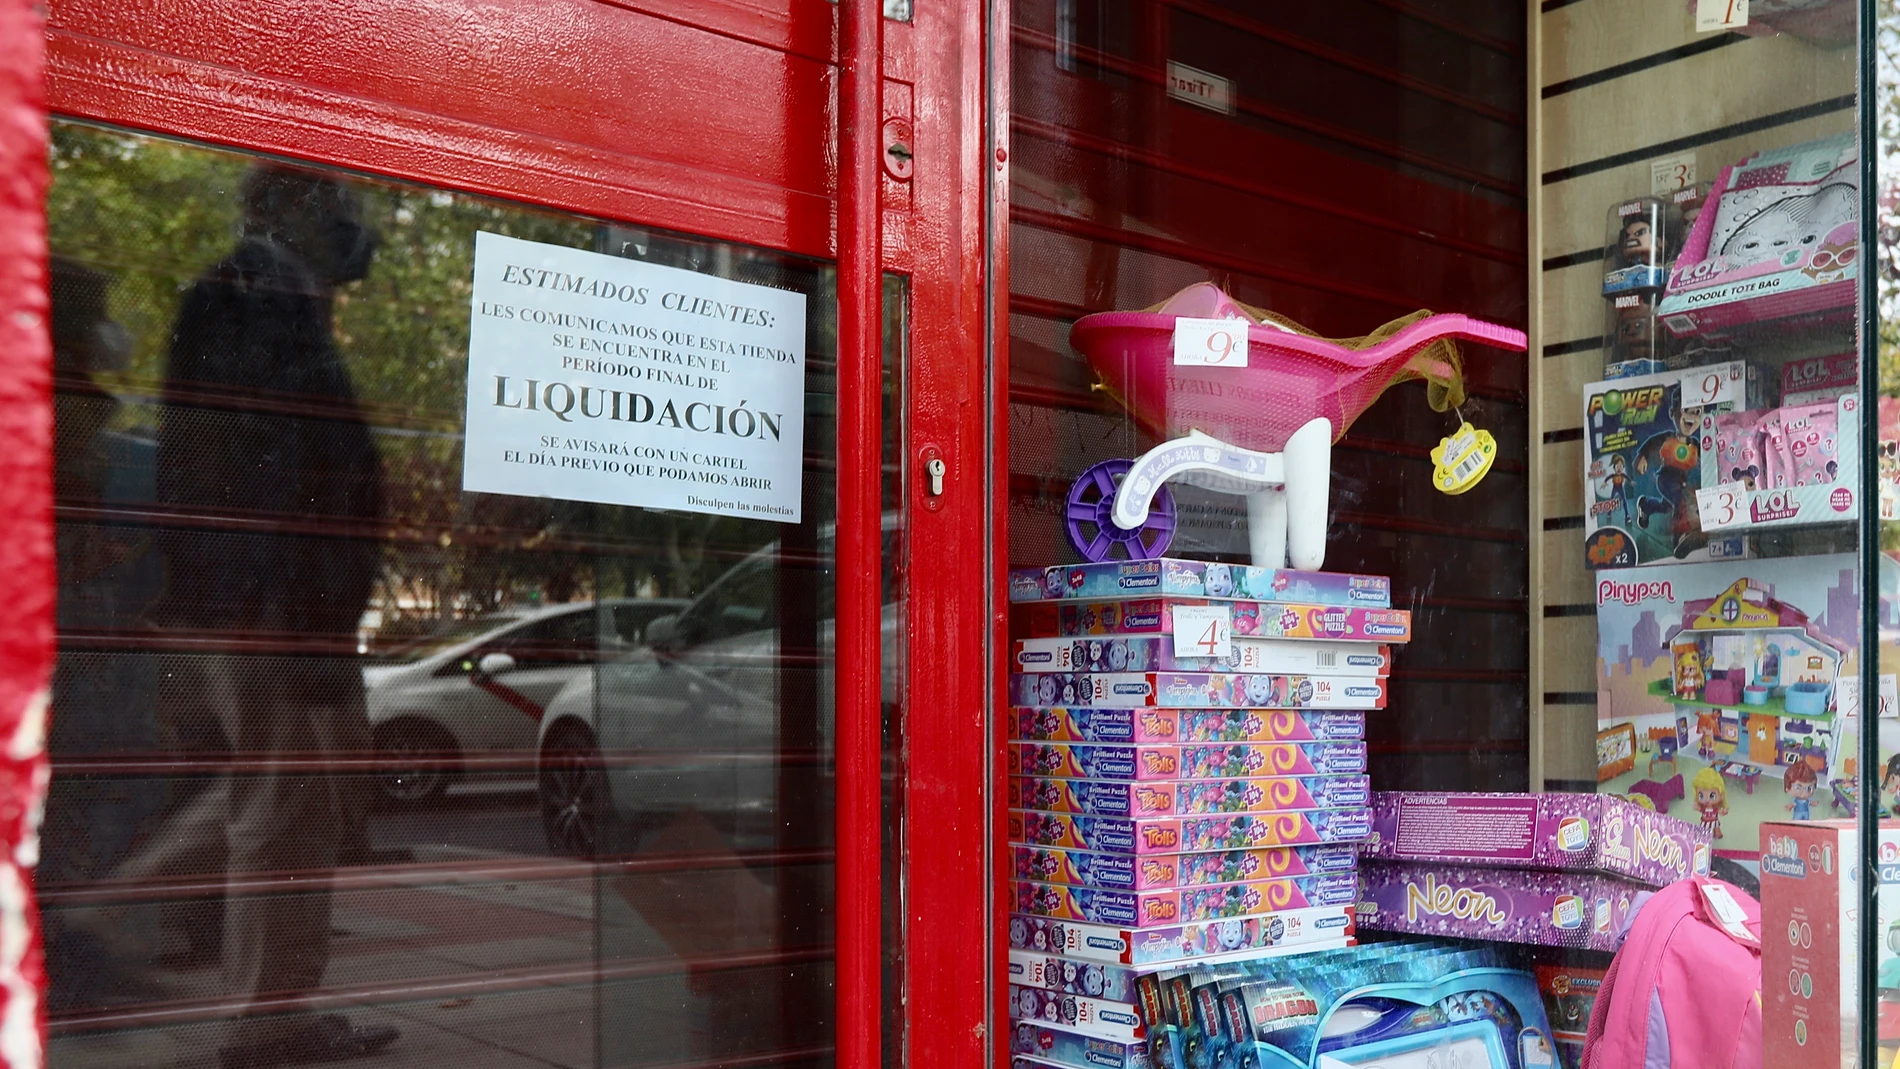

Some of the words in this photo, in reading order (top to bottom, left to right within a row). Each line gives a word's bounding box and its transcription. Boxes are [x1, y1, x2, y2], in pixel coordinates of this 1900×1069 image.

[1674, 188, 1697, 203] MARVEL
[1618, 203, 1641, 216] MARVEL
[501, 264, 649, 306] ESTIMADOS
[661, 291, 776, 328] CLIENTES:
[1688, 289, 1727, 304] DOODLE
[1731, 283, 1756, 295] TOTE
[1758, 278, 1781, 290] BAG
[1615, 295, 1639, 309] MARVEL
[481, 301, 515, 320] LES
[519, 307, 658, 342] COMUNICAMOS
[661, 329, 696, 348] QUE
[699, 336, 737, 355] ESTA
[739, 343, 797, 364] TIENDA
[552, 333, 575, 349] SE
[580, 337, 683, 366] ENCUENTRA
[686, 353, 707, 370] EN
[710, 358, 731, 374] EL
[562, 355, 642, 380] PERÍODO
[647, 367, 695, 388] FINAL
[697, 376, 719, 391] DE
[1792, 359, 1830, 381] LOL
[1588, 387, 1664, 416] POWER
[492, 374, 783, 443] LIQUIDACIÓN
[1788, 418, 1812, 431] LOL
[540, 435, 560, 449] SE
[563, 437, 630, 457] AVISARÁ
[634, 446, 666, 462] CON
[669, 450, 689, 464] UN
[692, 453, 748, 471] CARTEL
[503, 450, 526, 465] EL
[528, 449, 557, 467] DÍA
[560, 456, 620, 474] PREVIO
[623, 462, 655, 478] QUE
[658, 466, 729, 487] PODAMOS
[730, 477, 773, 491] ABRIR
[687, 494, 735, 511] Disculpen
[736, 500, 751, 512] las
[752, 501, 795, 516] molestias
[1756, 490, 1801, 514] LOL
[1590, 498, 1620, 518] ¡STOP!
[1757, 510, 1793, 522] SURPRISE!
[1616, 553, 1628, 563] x2
[1126, 577, 1158, 588] Clementoni
[1356, 591, 1386, 601] Clementoni
[1599, 580, 1675, 607] Pinypon
[1131, 616, 1159, 627] Clementoni
[1323, 613, 1346, 622] GLITTER
[1324, 622, 1345, 632] PUZZLE
[1373, 625, 1404, 635] Clementoni
[1025, 653, 1051, 661] Clementoni
[1062, 646, 1070, 668] 104
[1244, 646, 1253, 668] 104
[1095, 678, 1103, 700] 104
[1316, 681, 1331, 692] 104
[1350, 687, 1379, 696] Clementoni
[1113, 713, 1131, 721] Puzzle
[1100, 725, 1129, 734] Clementoni
[1330, 726, 1360, 734] Clementoni
[1116, 751, 1133, 759] Puzzle
[1102, 763, 1133, 772] Clementoni
[1331, 758, 1361, 767] Clementoni
[1333, 792, 1365, 801] Clementoni
[1403, 797, 1448, 805] ADVERTENCIAS
[1098, 799, 1127, 808] Clementoni
[1116, 824, 1134, 832] Puzzle
[1336, 825, 1368, 834] Clementoni
[1563, 824, 1581, 835] CEFA
[1103, 835, 1133, 846] Clementoni
[1566, 834, 1584, 845] TOYS
[1634, 815, 1687, 874] Neon
[1770, 835, 1798, 860] baby
[1323, 857, 1352, 866] Clementoni
[1771, 858, 1804, 876] Clementoni
[1100, 871, 1132, 882] Clementoni
[1325, 890, 1353, 899] Clementoni
[1407, 874, 1505, 925] Neon
[1116, 896, 1135, 905] Puzzle
[1103, 907, 1134, 918] Clementoni
[1558, 903, 1576, 913] CEFA
[1286, 917, 1301, 928] 104
[1320, 918, 1347, 927] Clementoni
[1560, 911, 1579, 923] TOYS
[1067, 928, 1075, 950] 104
[1034, 962, 1043, 983] 104
[1079, 1001, 1087, 1023] 104
[1254, 999, 1319, 1026] DRAGON
[1274, 1020, 1298, 1031] HIDDEN
[1092, 1053, 1122, 1067] Clementoni
